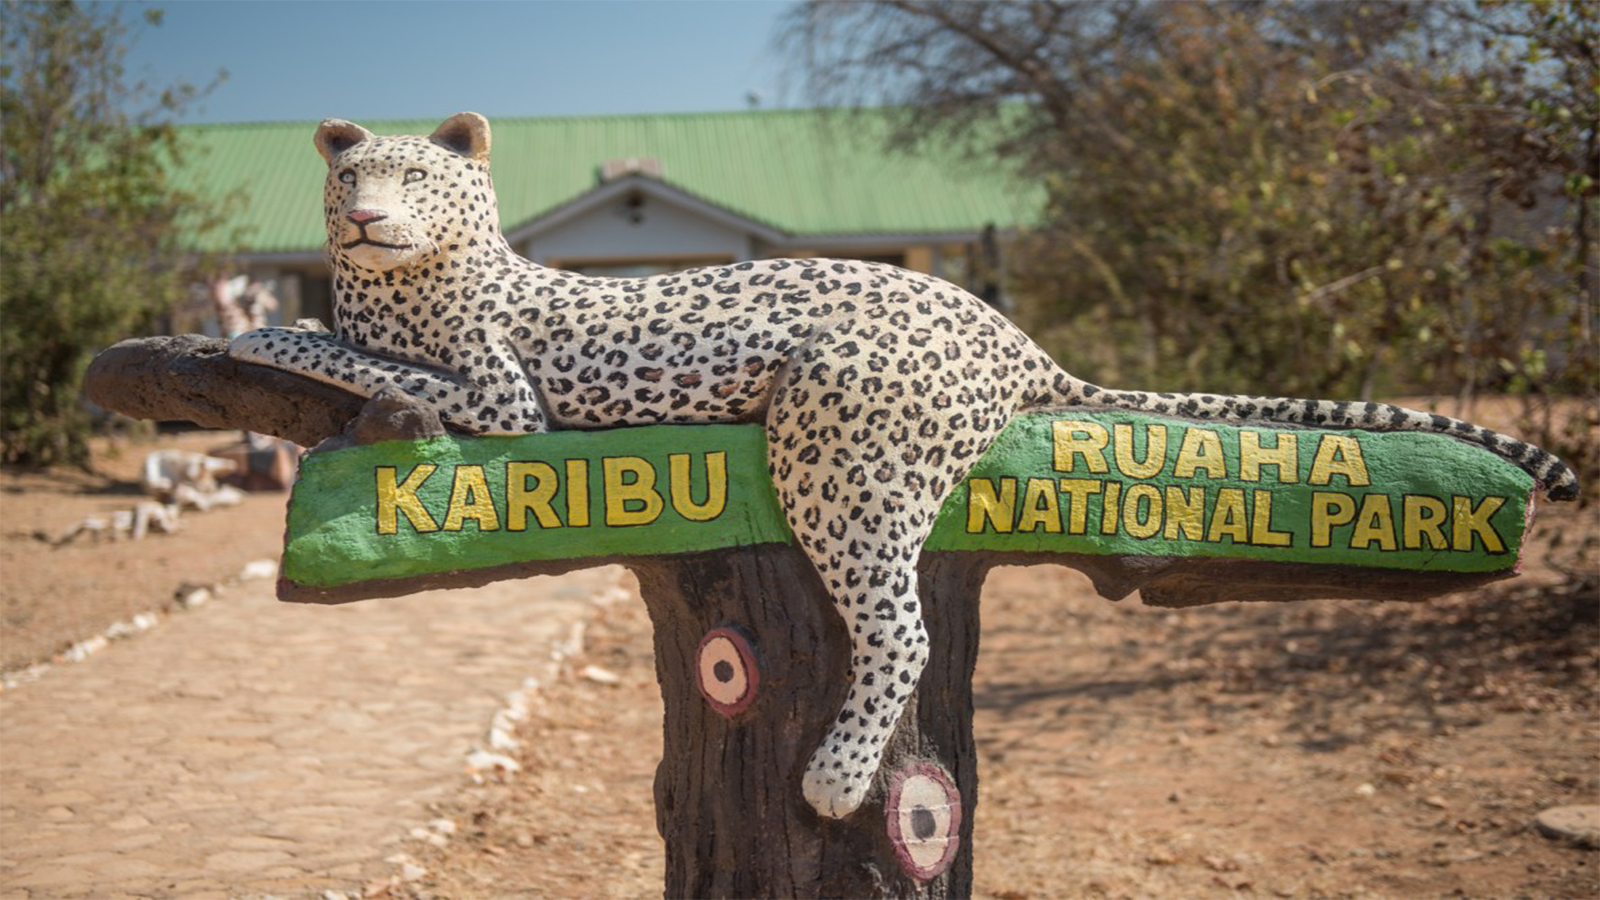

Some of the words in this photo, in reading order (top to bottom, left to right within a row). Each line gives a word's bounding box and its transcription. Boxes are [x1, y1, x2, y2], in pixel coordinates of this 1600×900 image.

[375, 451, 728, 534] KARIBU
[1051, 420, 1370, 486] RUAHA
[967, 476, 1293, 546] NATIONAL
[1310, 492, 1508, 555] PARK
